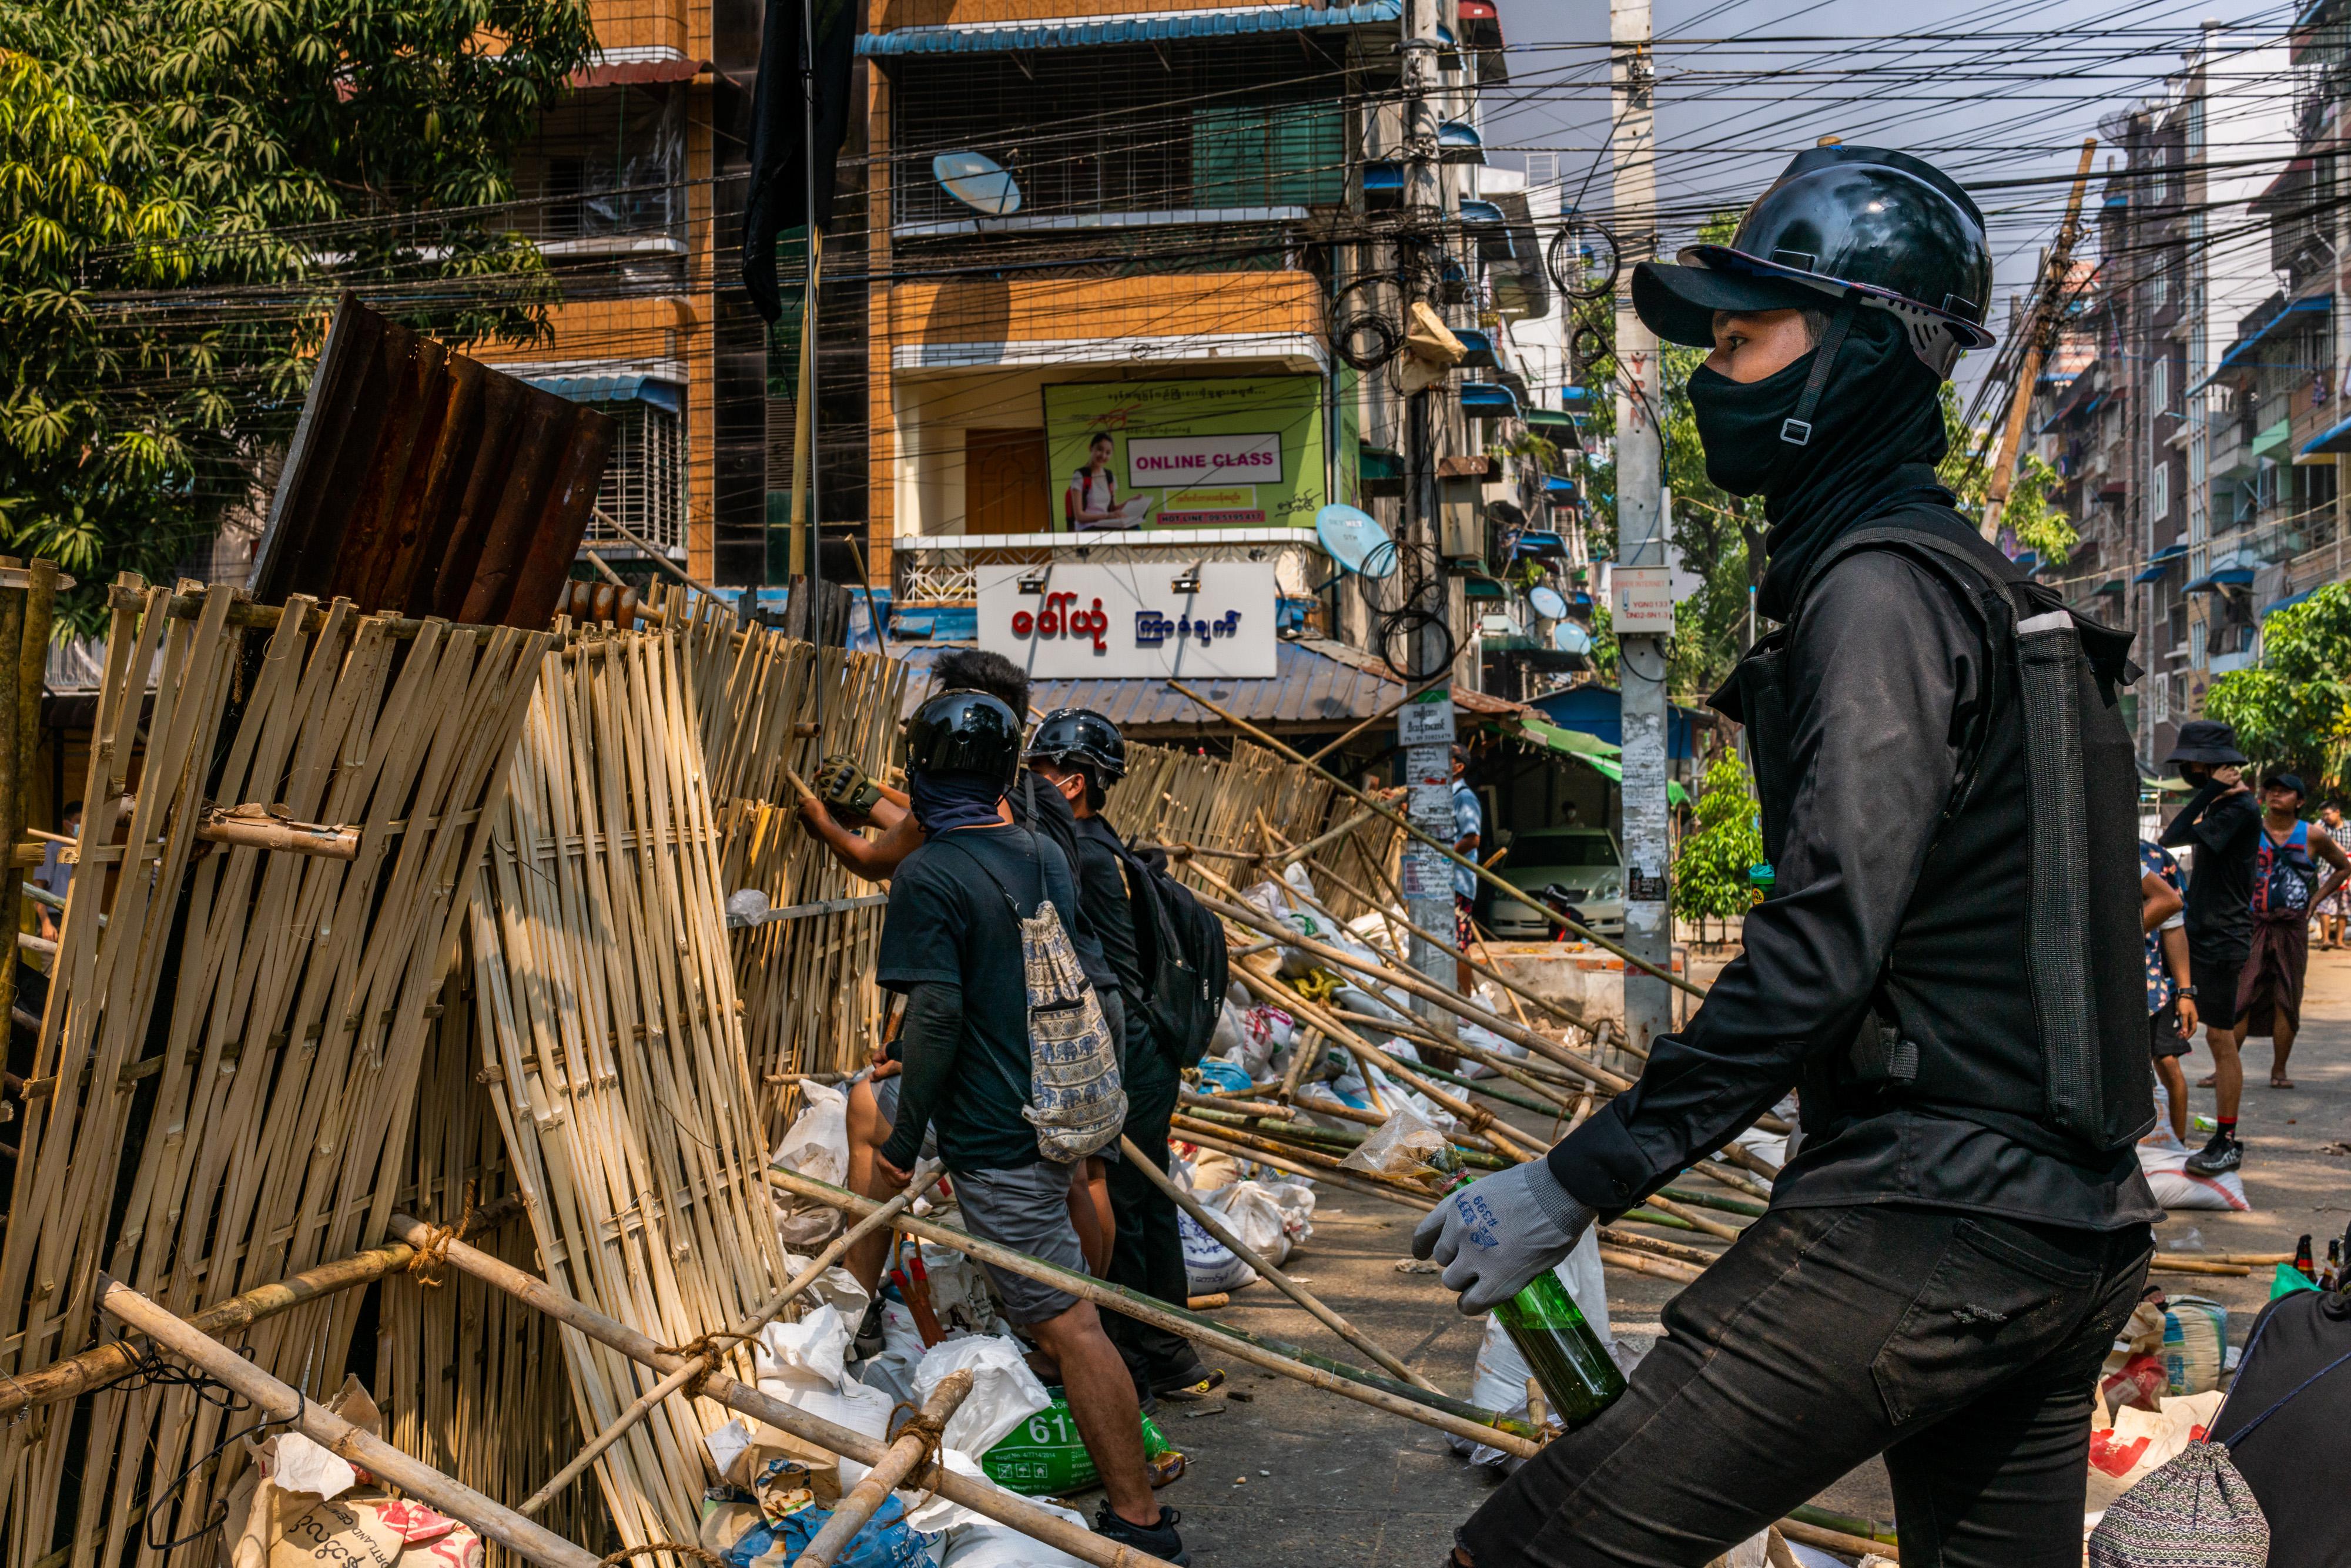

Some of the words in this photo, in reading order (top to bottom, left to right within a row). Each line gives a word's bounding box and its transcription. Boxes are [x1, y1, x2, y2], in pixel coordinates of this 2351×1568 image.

[1136, 455, 1206, 470] ONLINE
[1212, 452, 1274, 467] CLASS
[1012, 592, 1108, 649] ဒေါ်ယုံ
[1473, 1195, 1498, 1227] #399
